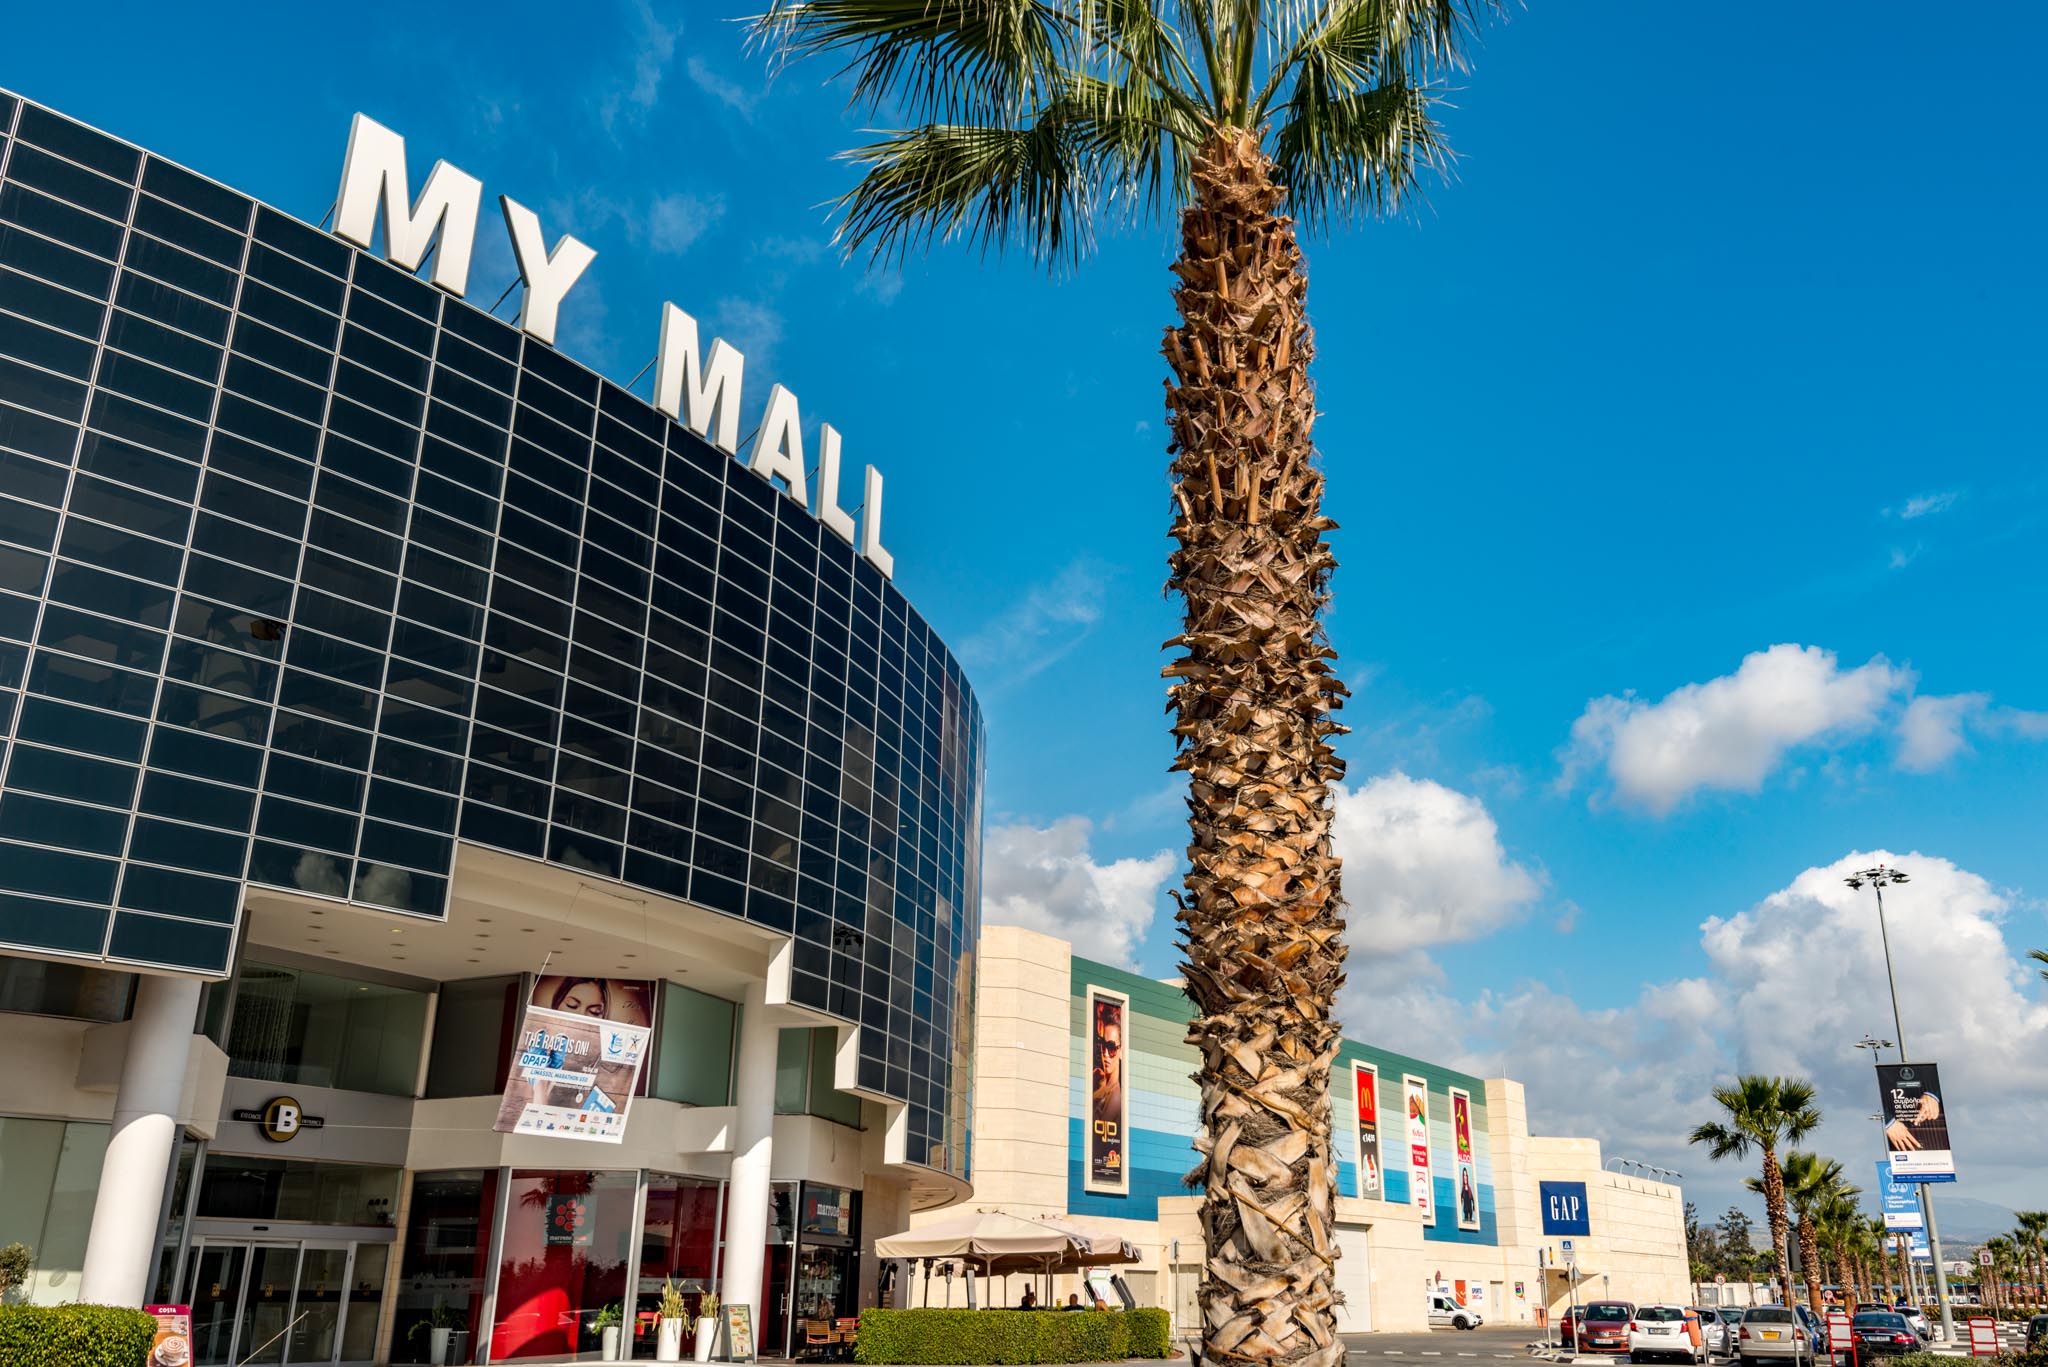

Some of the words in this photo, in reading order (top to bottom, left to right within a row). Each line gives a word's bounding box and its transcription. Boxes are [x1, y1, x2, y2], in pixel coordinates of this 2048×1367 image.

[331, 112, 597, 345] MY
[654, 301, 893, 580] MALL
[524, 1031, 543, 1048] THE
[542, 1034, 564, 1051] RACE
[566, 1038, 575, 1054] IS
[574, 1040, 590, 1056] ON!
[522, 1054, 547, 1066] OPAP
[530, 1069, 553, 1077] LIMASSOL
[554, 1072, 578, 1080] MARATHON
[1890, 1088, 1905, 1099] 12
[276, 1104, 298, 1132] B
[1550, 1195, 1579, 1221] GAP
[1982, 1255, 1990, 1263] D
